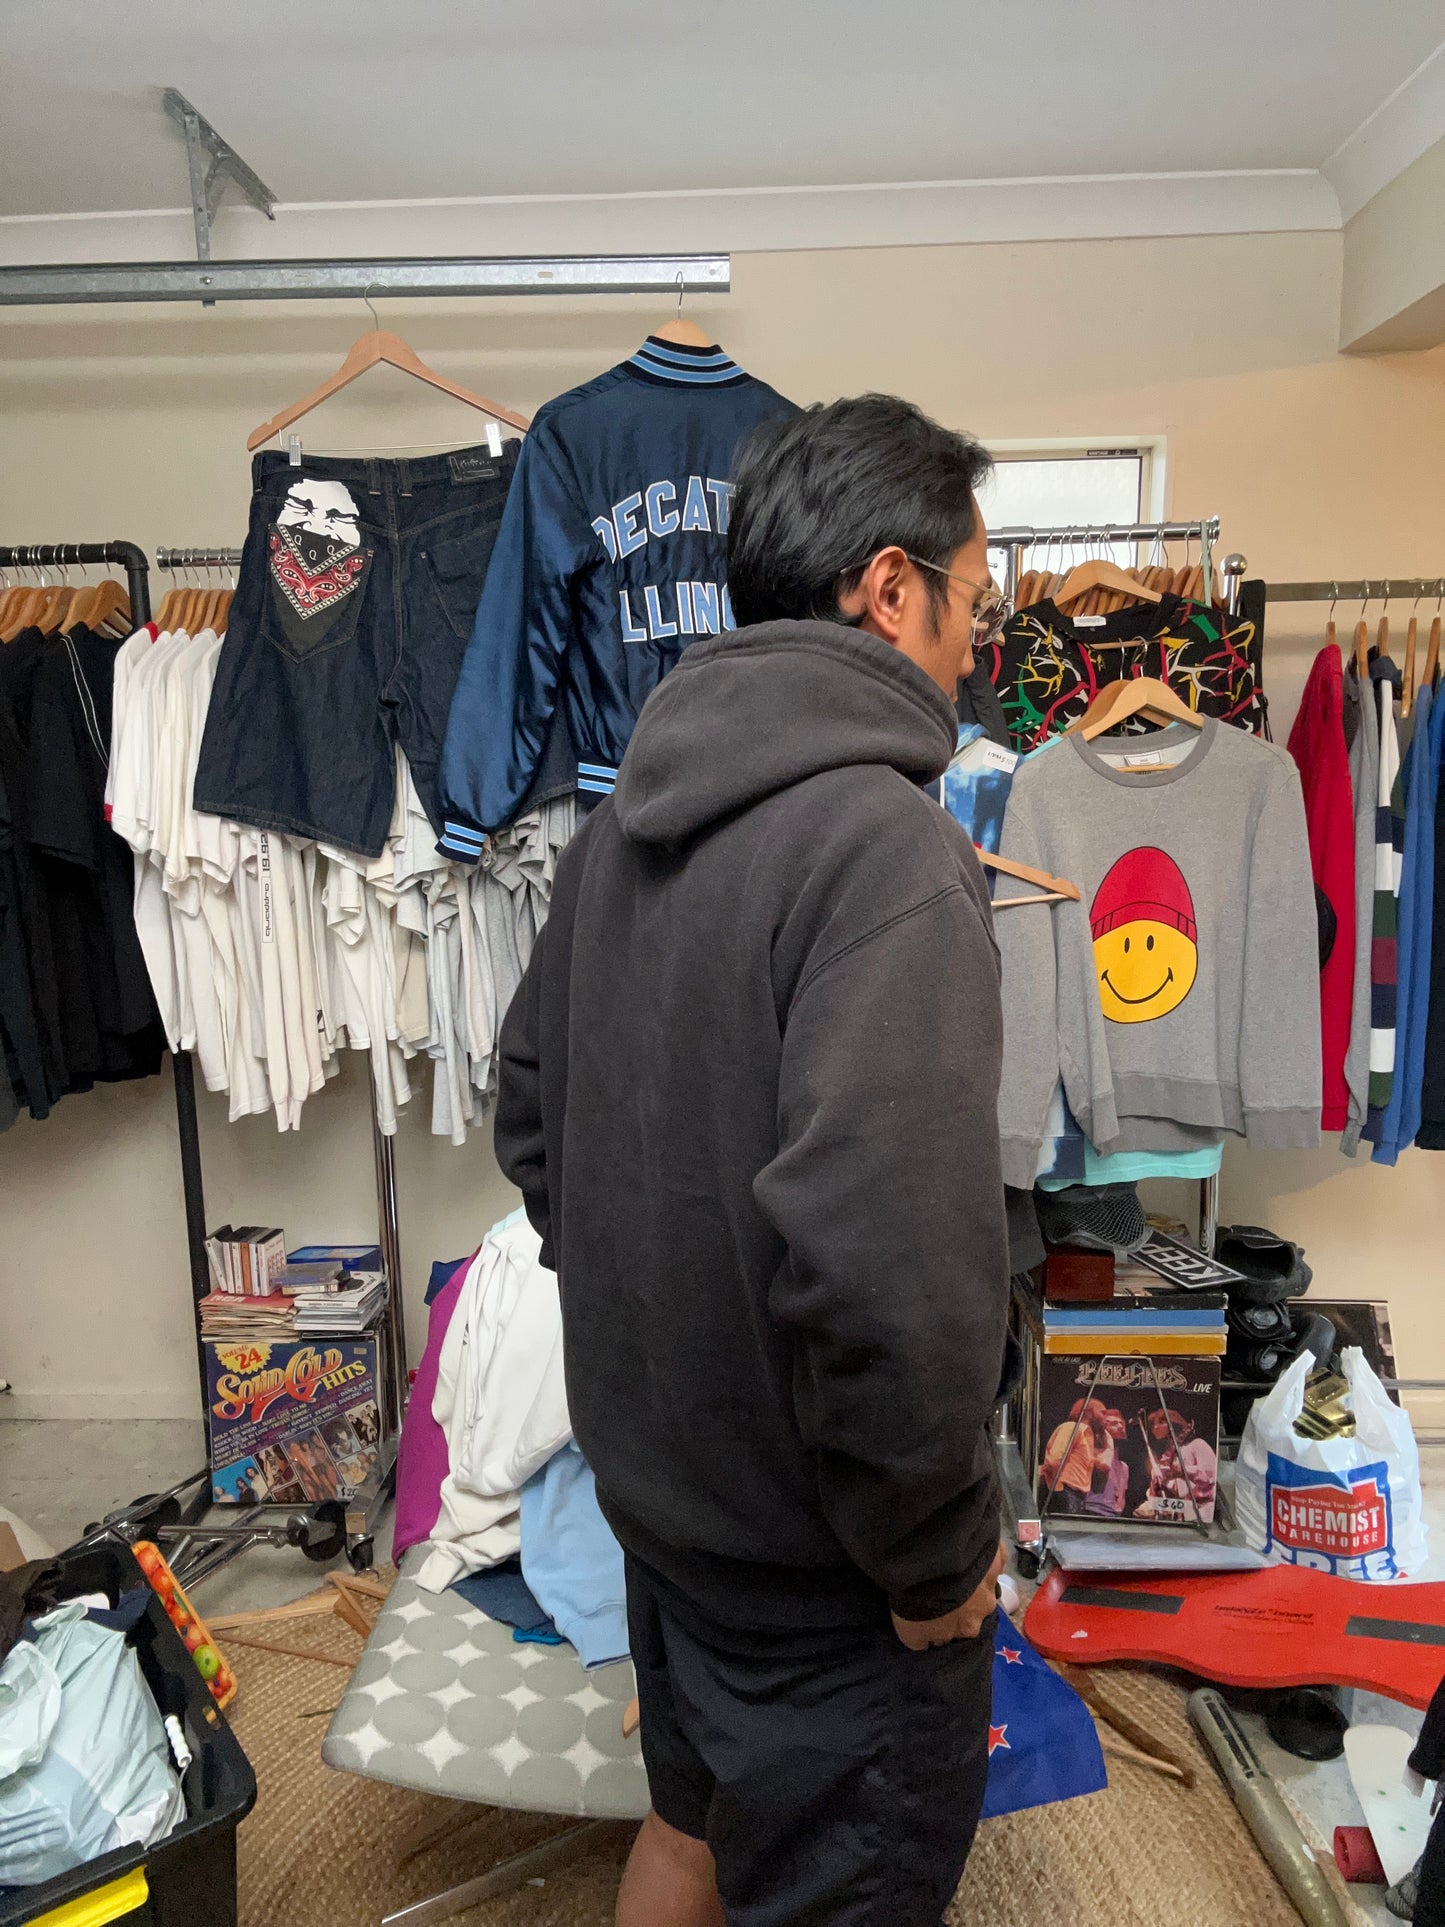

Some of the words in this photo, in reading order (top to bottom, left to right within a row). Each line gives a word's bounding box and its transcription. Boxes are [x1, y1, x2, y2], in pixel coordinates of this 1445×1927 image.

[1140, 1243, 1223, 1281] KEEP
[235, 1348, 263, 1370] 24
[321, 1361, 367, 1390] HITS
[1278, 1498, 1380, 1534] CHEMIST
[1277, 1520, 1379, 1547] WAREHOUSE
